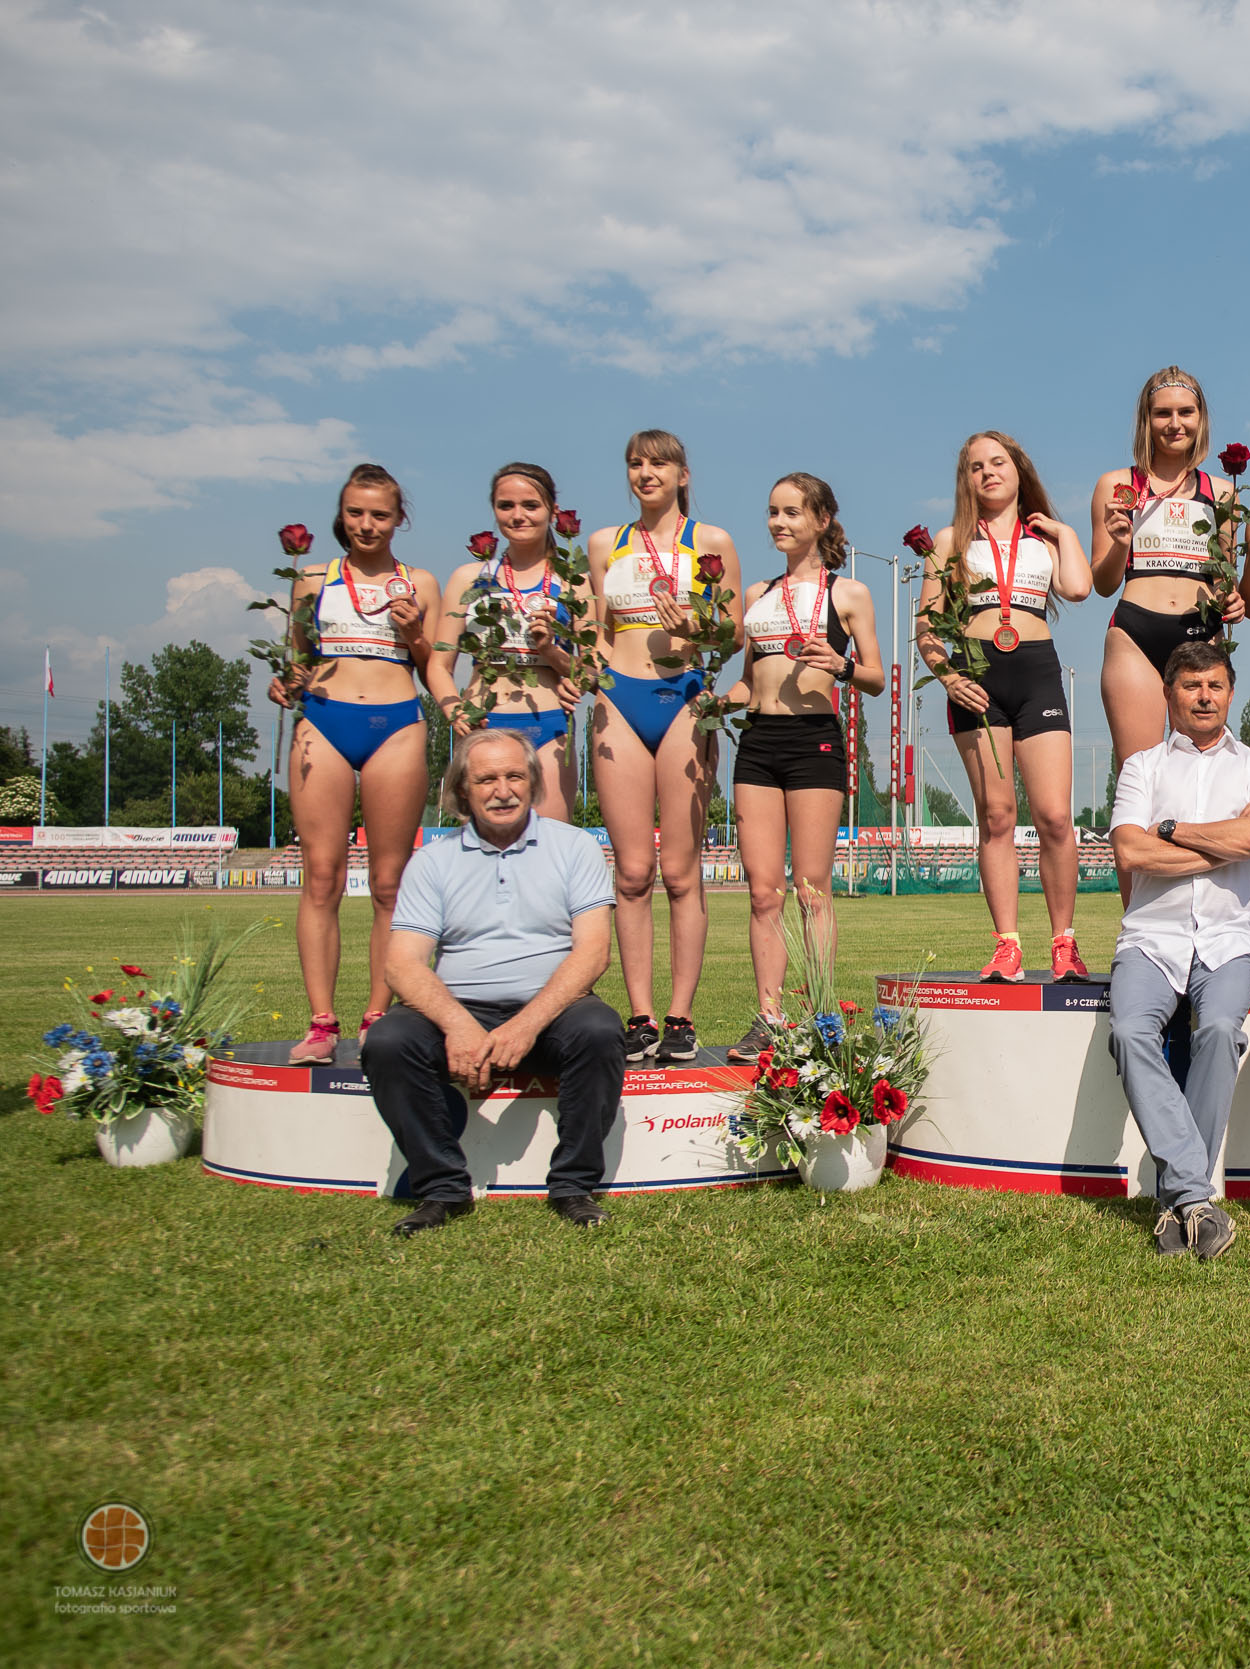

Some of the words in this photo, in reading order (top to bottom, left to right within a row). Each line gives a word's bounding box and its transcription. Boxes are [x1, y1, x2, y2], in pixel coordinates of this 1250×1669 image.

[1137, 536, 1160, 549] 100
[1191, 539, 1207, 547] ZWIĄZ
[1146, 558, 1182, 568] KRAKÓW
[1184, 562, 1202, 570] 2019
[979, 594, 1017, 603] KRAW
[1020, 596, 1036, 605] 2019
[760, 641, 783, 651] RAKÓ
[172, 833, 217, 842] 4MOVE
[0, 873, 22, 881] OVE
[44, 870, 114, 885] 4MOVE
[119, 870, 187, 885] 4MOVE
[1025, 869, 1040, 878] BLA
[943, 988, 968, 996] POLSKI
[954, 998, 1000, 1007] SZTAFETACH
[1065, 998, 1078, 1006] 8-9
[1079, 998, 1111, 1007] CZERWC
[630, 1073, 665, 1081] POLSKI
[329, 1081, 341, 1089] 8-9
[342, 1082, 371, 1092] CZERWC
[646, 1081, 708, 1091] SZTAFETACH
[661, 1112, 727, 1133] polanik
